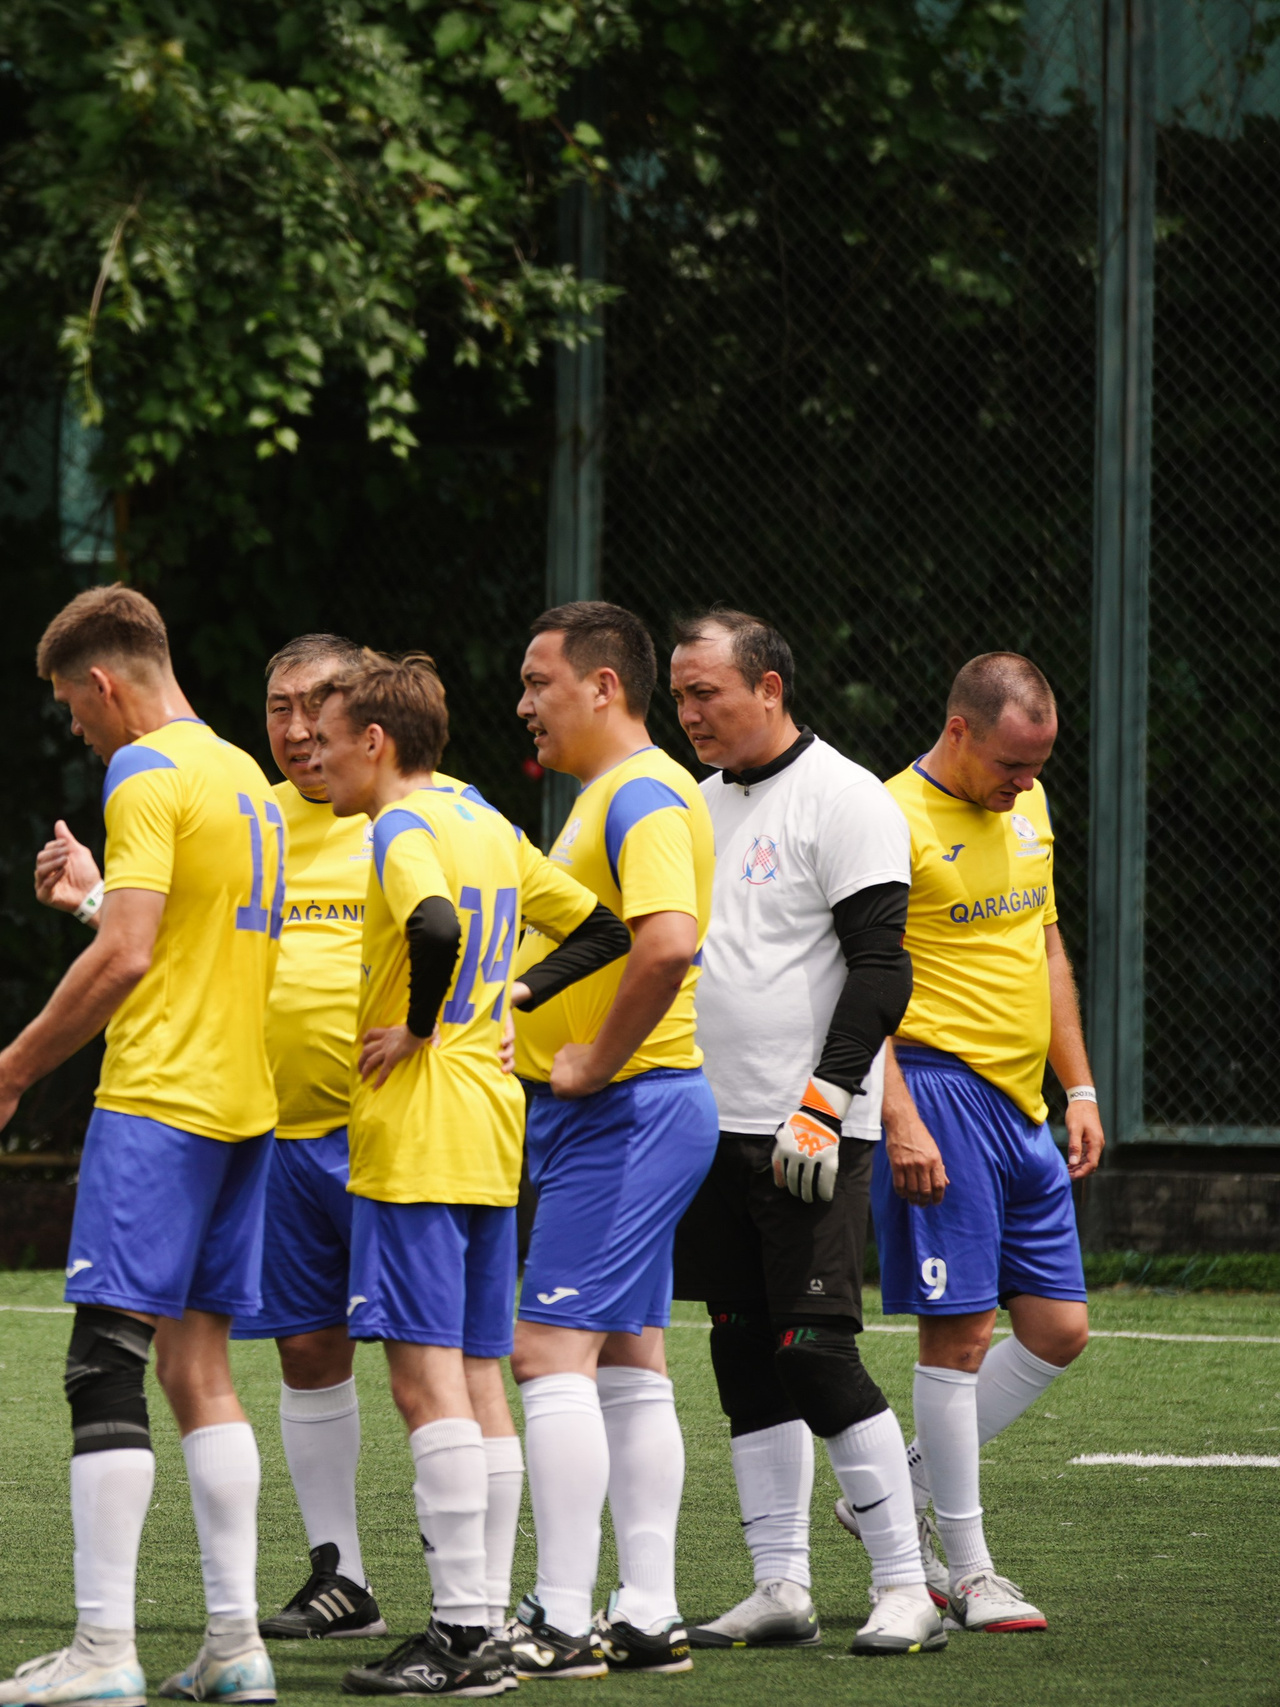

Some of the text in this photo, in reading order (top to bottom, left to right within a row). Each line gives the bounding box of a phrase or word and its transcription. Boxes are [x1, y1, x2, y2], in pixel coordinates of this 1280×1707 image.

[235, 792, 286, 941] 11
[442, 886, 517, 1025] 14
[922, 1257, 947, 1300] 9
